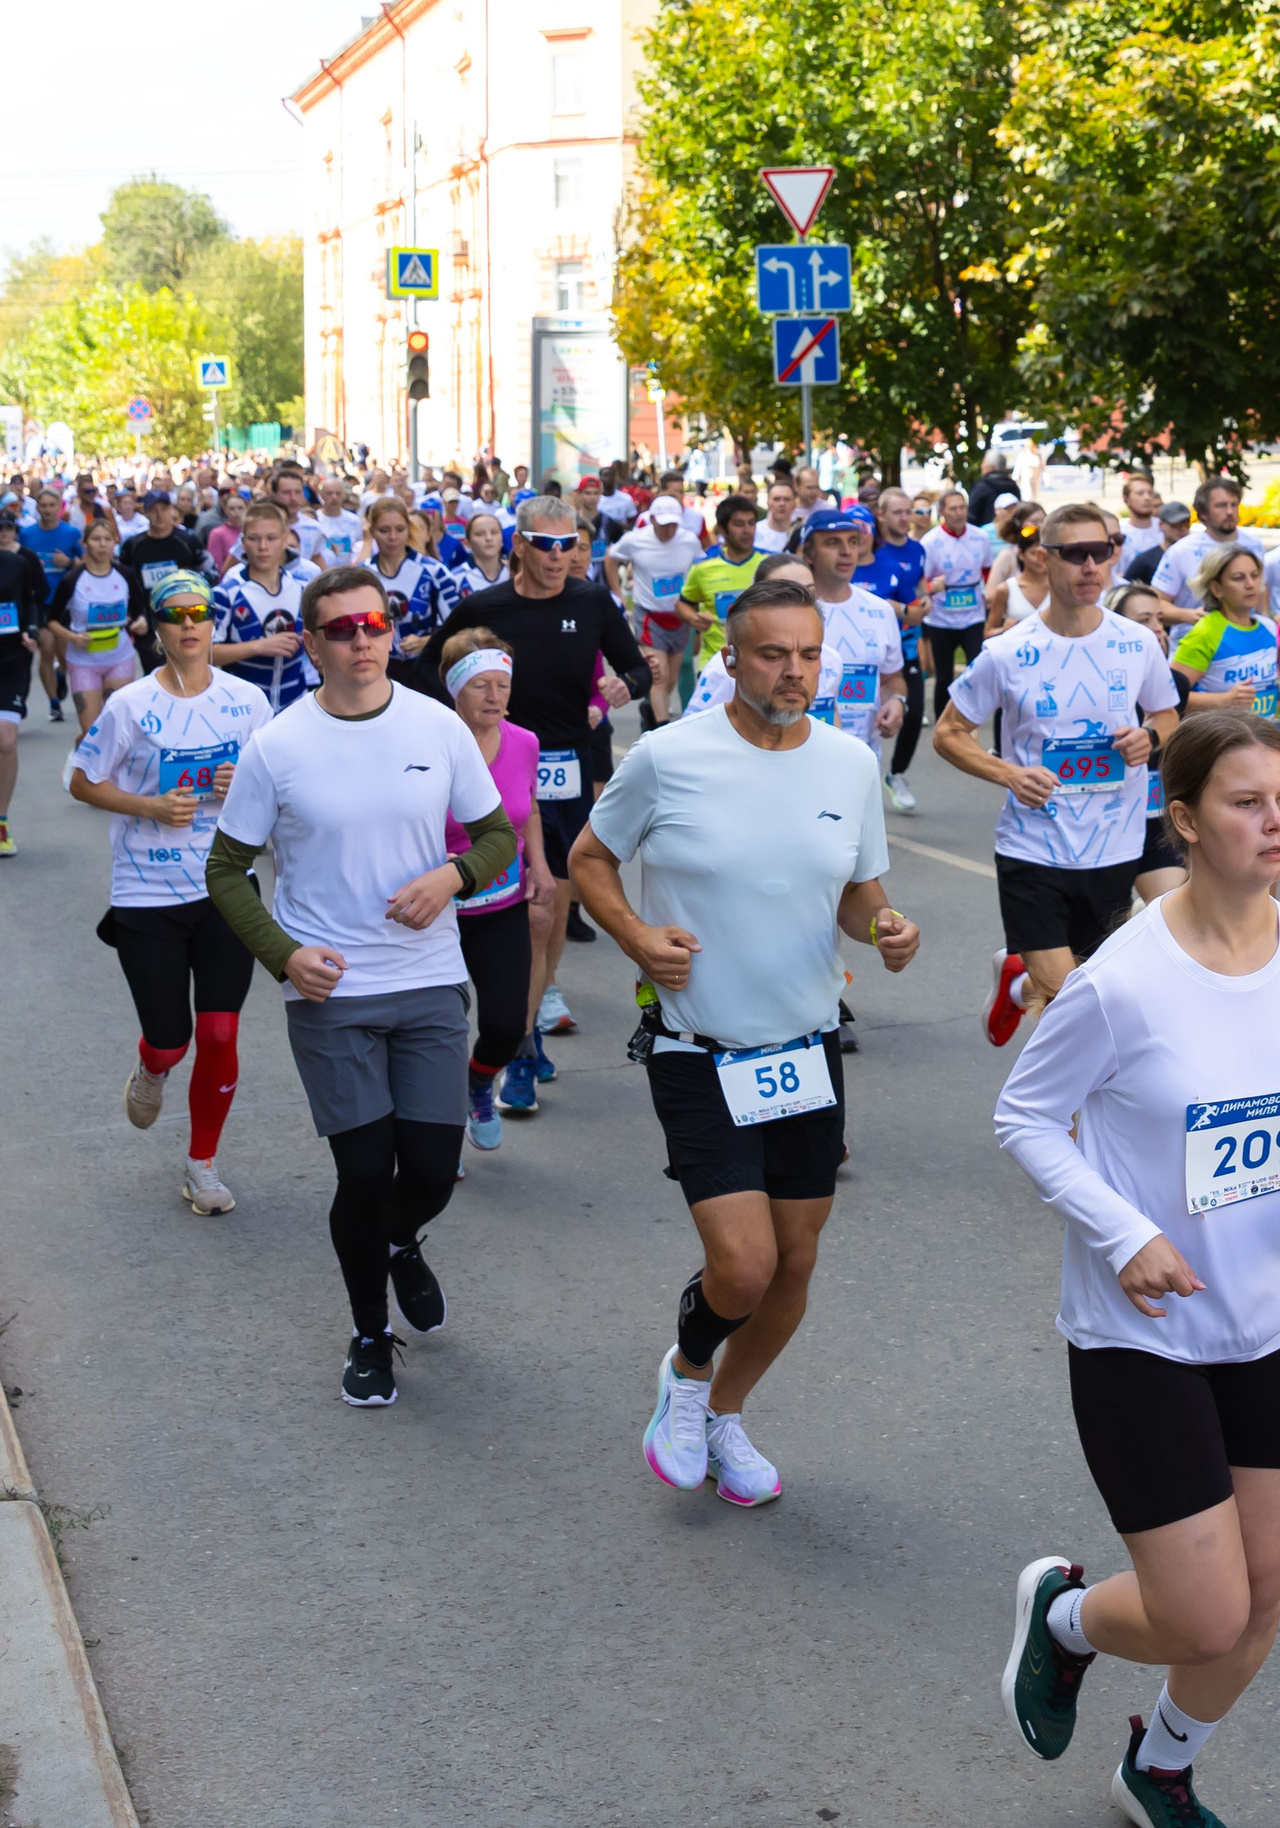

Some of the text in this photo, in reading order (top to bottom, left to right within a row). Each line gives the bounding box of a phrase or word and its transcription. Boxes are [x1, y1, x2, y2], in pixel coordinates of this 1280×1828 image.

[1058, 756, 1110, 779] 695
[760, 1045, 783, 1055] МИЛЯ
[755, 1061, 800, 1099] 58
[1246, 1105, 1278, 1118] МИЛЯ
